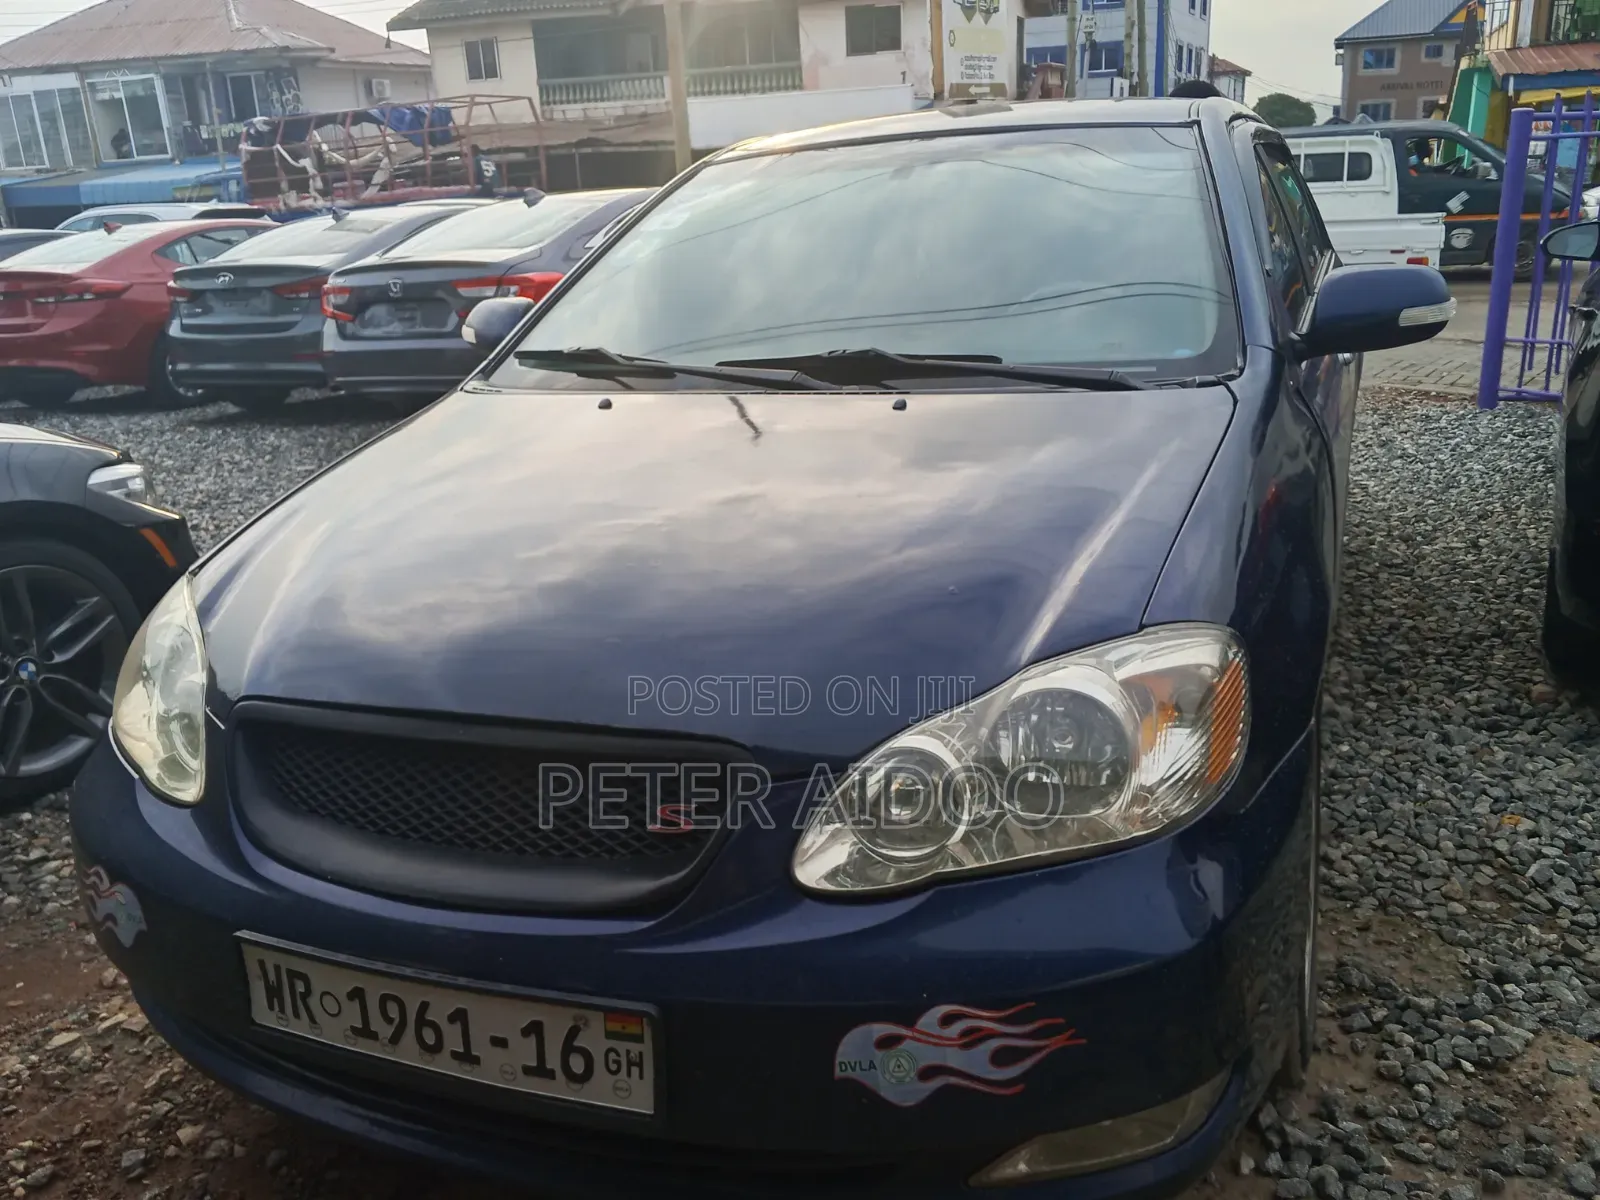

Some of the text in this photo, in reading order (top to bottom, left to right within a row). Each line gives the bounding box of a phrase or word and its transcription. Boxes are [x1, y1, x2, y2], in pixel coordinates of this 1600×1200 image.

[257, 958, 317, 1024] WR
[604, 1046, 644, 1080] GH
[838, 1060, 878, 1072] DVLA
